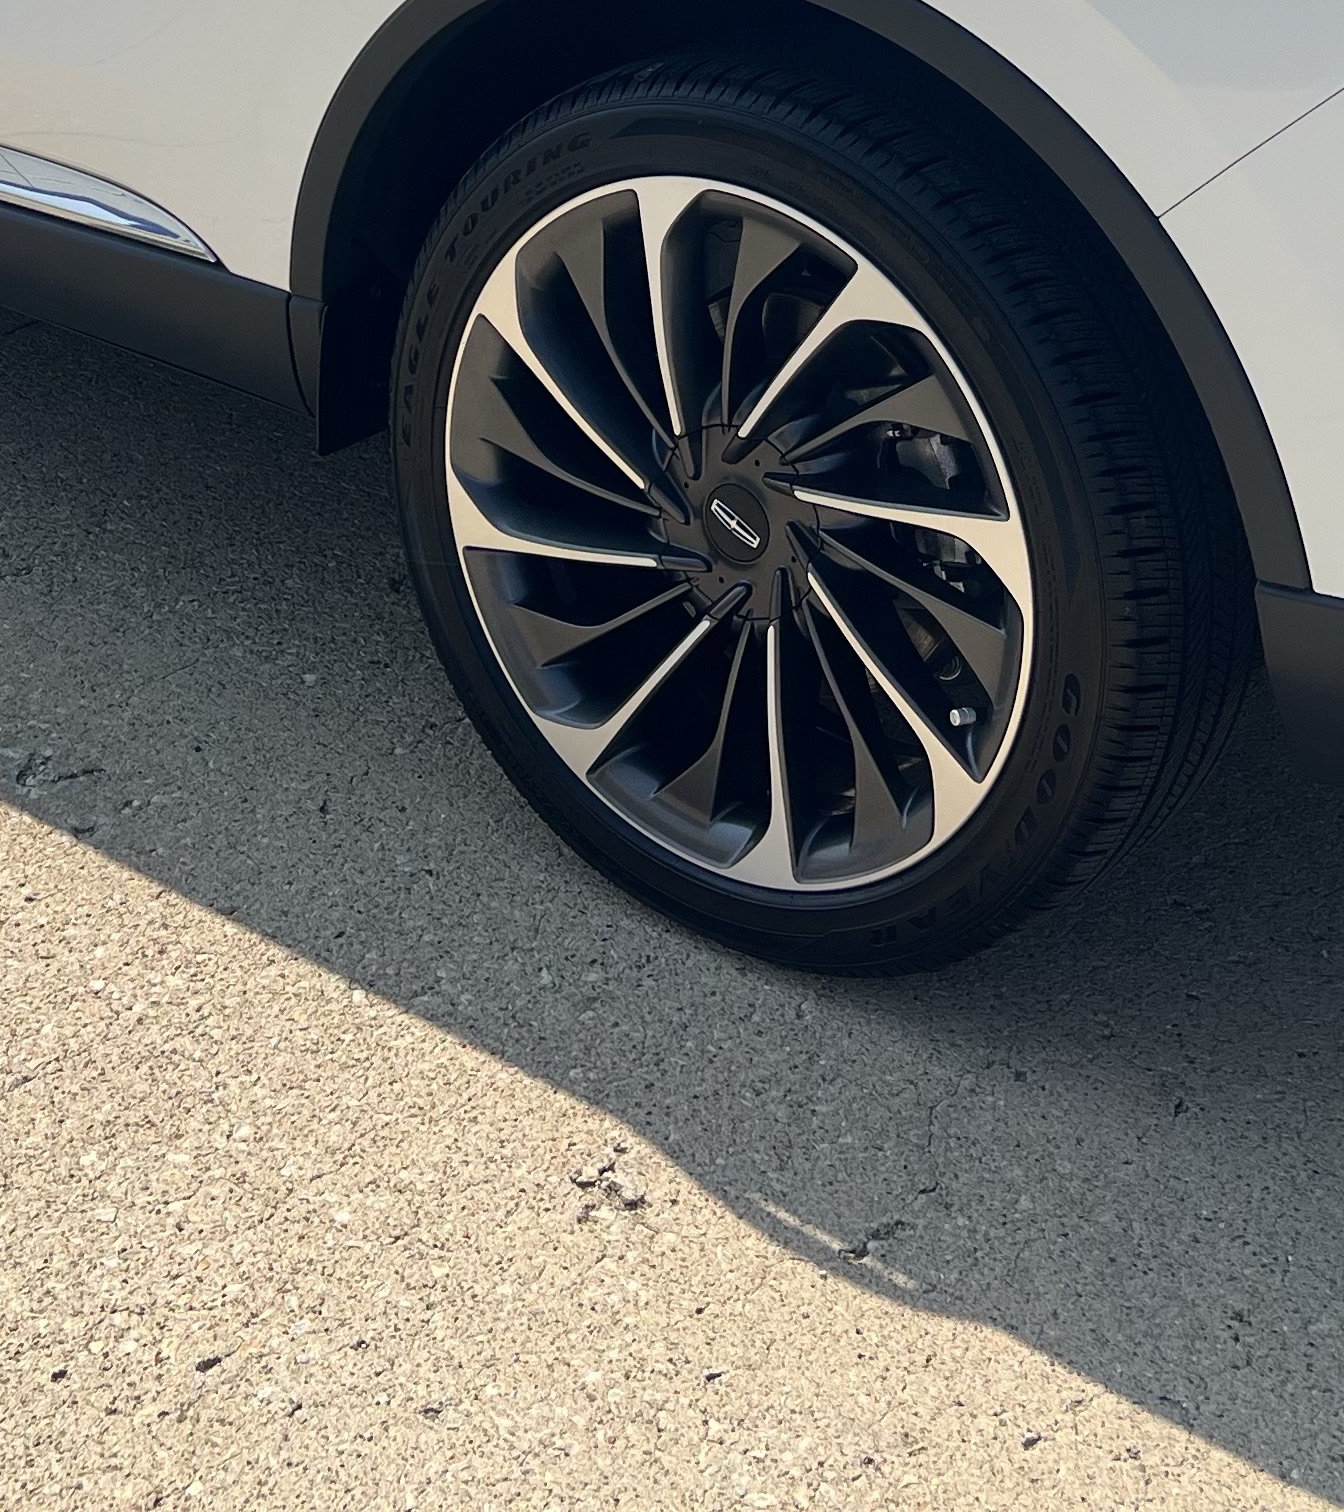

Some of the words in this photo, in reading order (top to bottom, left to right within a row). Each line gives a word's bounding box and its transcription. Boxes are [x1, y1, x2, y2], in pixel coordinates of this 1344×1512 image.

[444, 131, 593, 264] TOURING
[400, 278, 440, 449] EAGLE
[869, 672, 1083, 947] GOODYEAR
